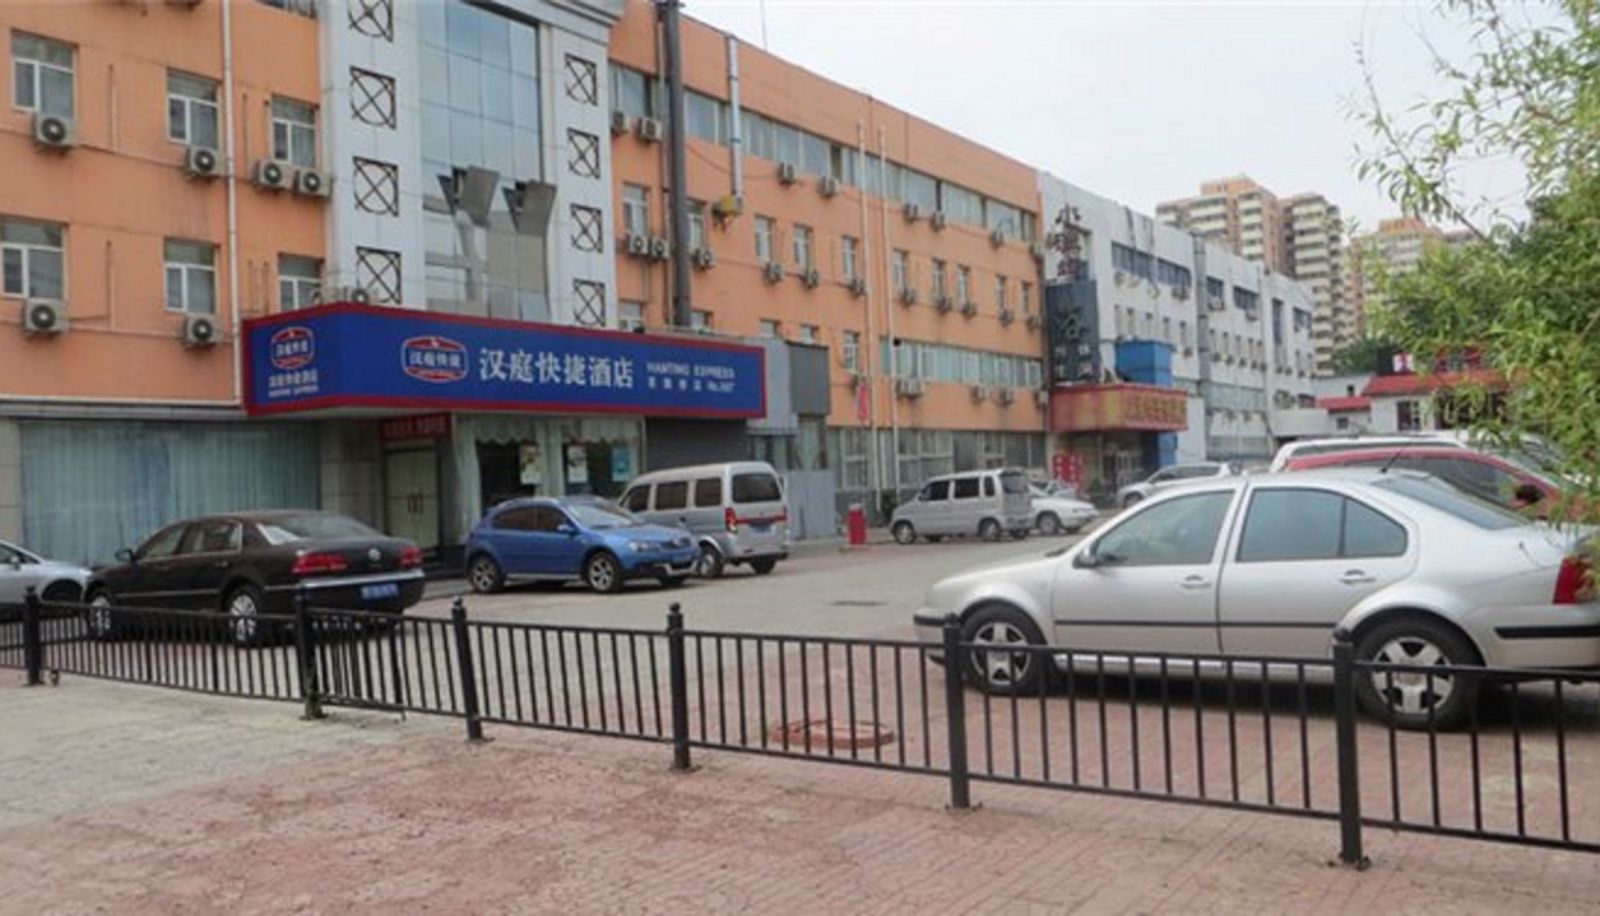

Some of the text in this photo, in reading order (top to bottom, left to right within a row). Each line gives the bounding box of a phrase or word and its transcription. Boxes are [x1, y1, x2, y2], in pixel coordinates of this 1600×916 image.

[480, 347, 634, 388] 汉庭快捷酒店
